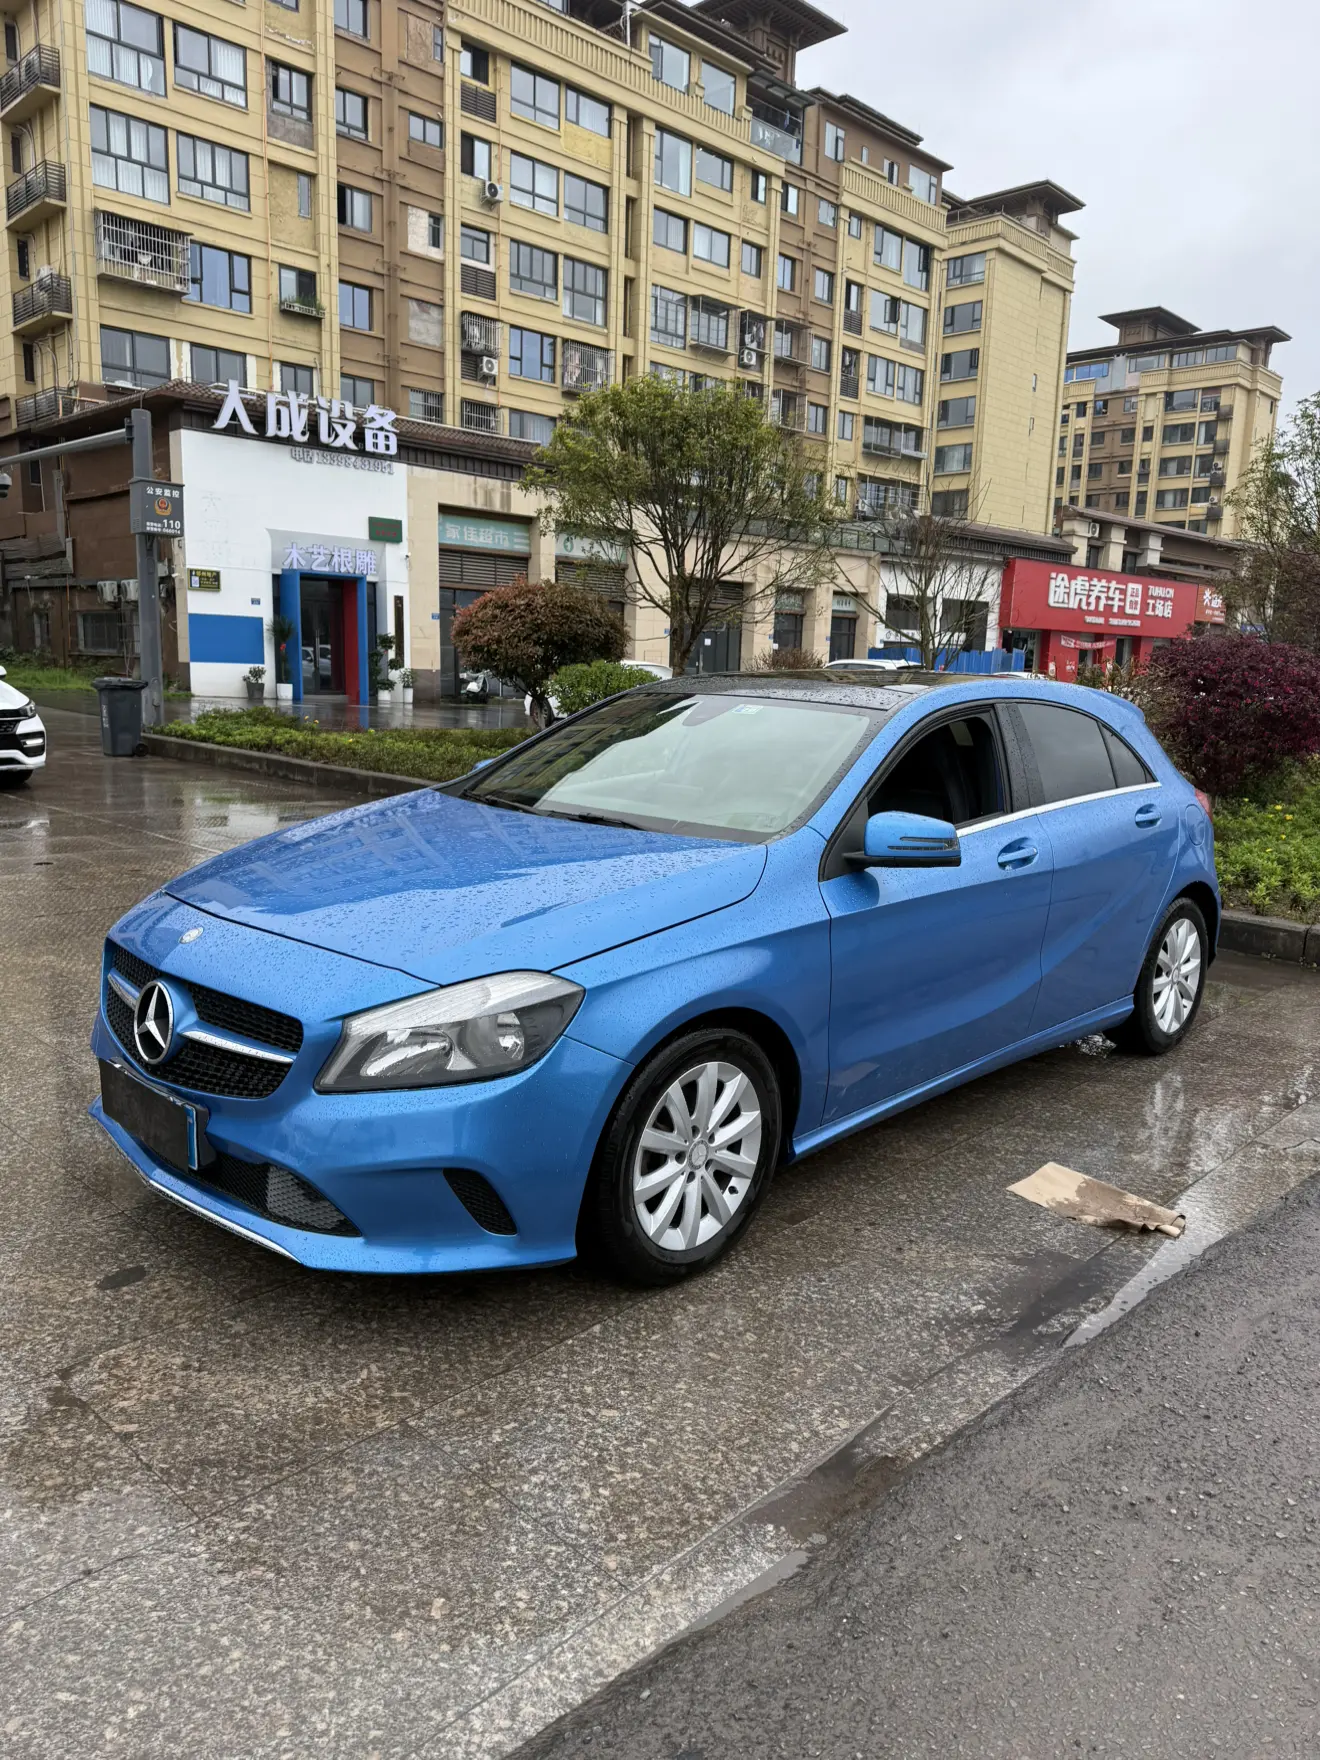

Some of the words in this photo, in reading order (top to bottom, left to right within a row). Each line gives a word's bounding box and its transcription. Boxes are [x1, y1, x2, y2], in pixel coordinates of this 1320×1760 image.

[210, 379, 399, 455] 大成设备
[146, 486, 180, 499] 公安监控
[163, 519, 181, 530] 110
[283, 542, 377, 575] 木艺根雕
[1048, 572, 1126, 613] 途虎养车
[1145, 599, 1173, 618] 工场店
